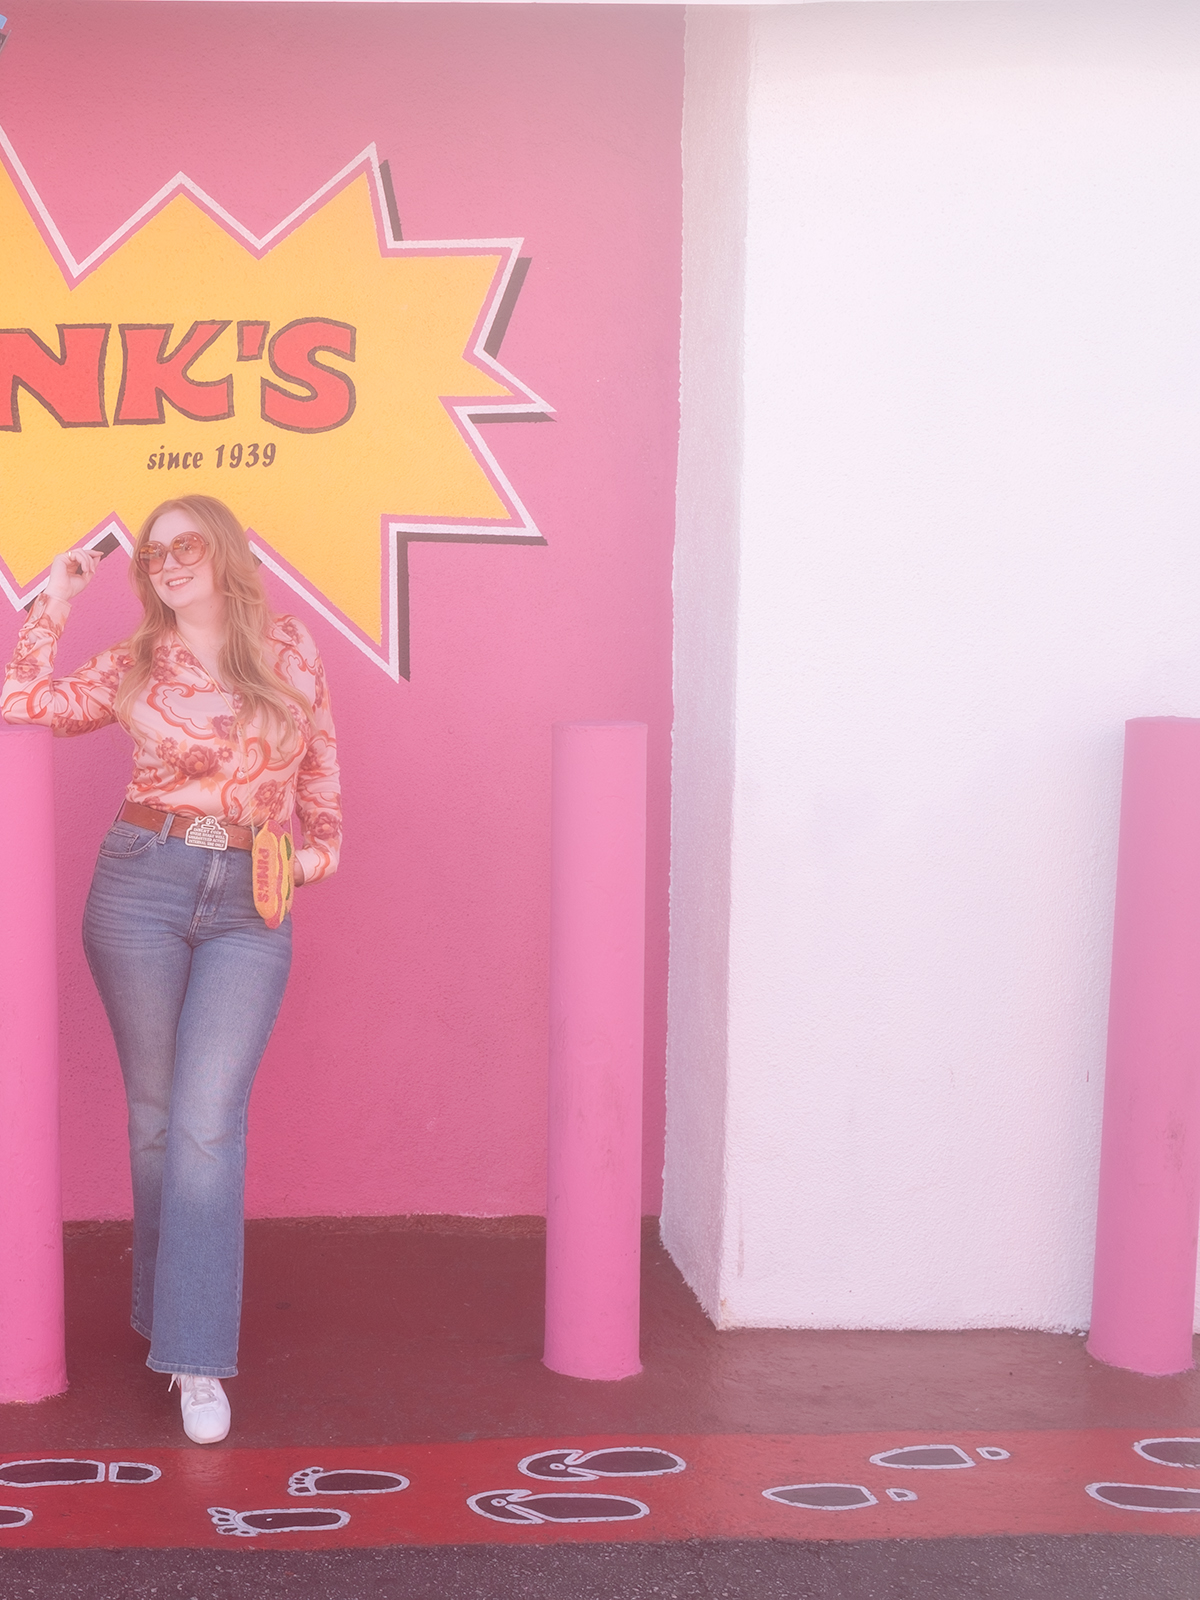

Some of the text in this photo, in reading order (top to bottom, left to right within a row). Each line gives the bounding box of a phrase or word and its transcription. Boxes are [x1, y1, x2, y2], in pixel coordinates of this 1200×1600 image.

[147, 442, 277, 471] since 1939
[257, 848, 269, 903] PINK'S
